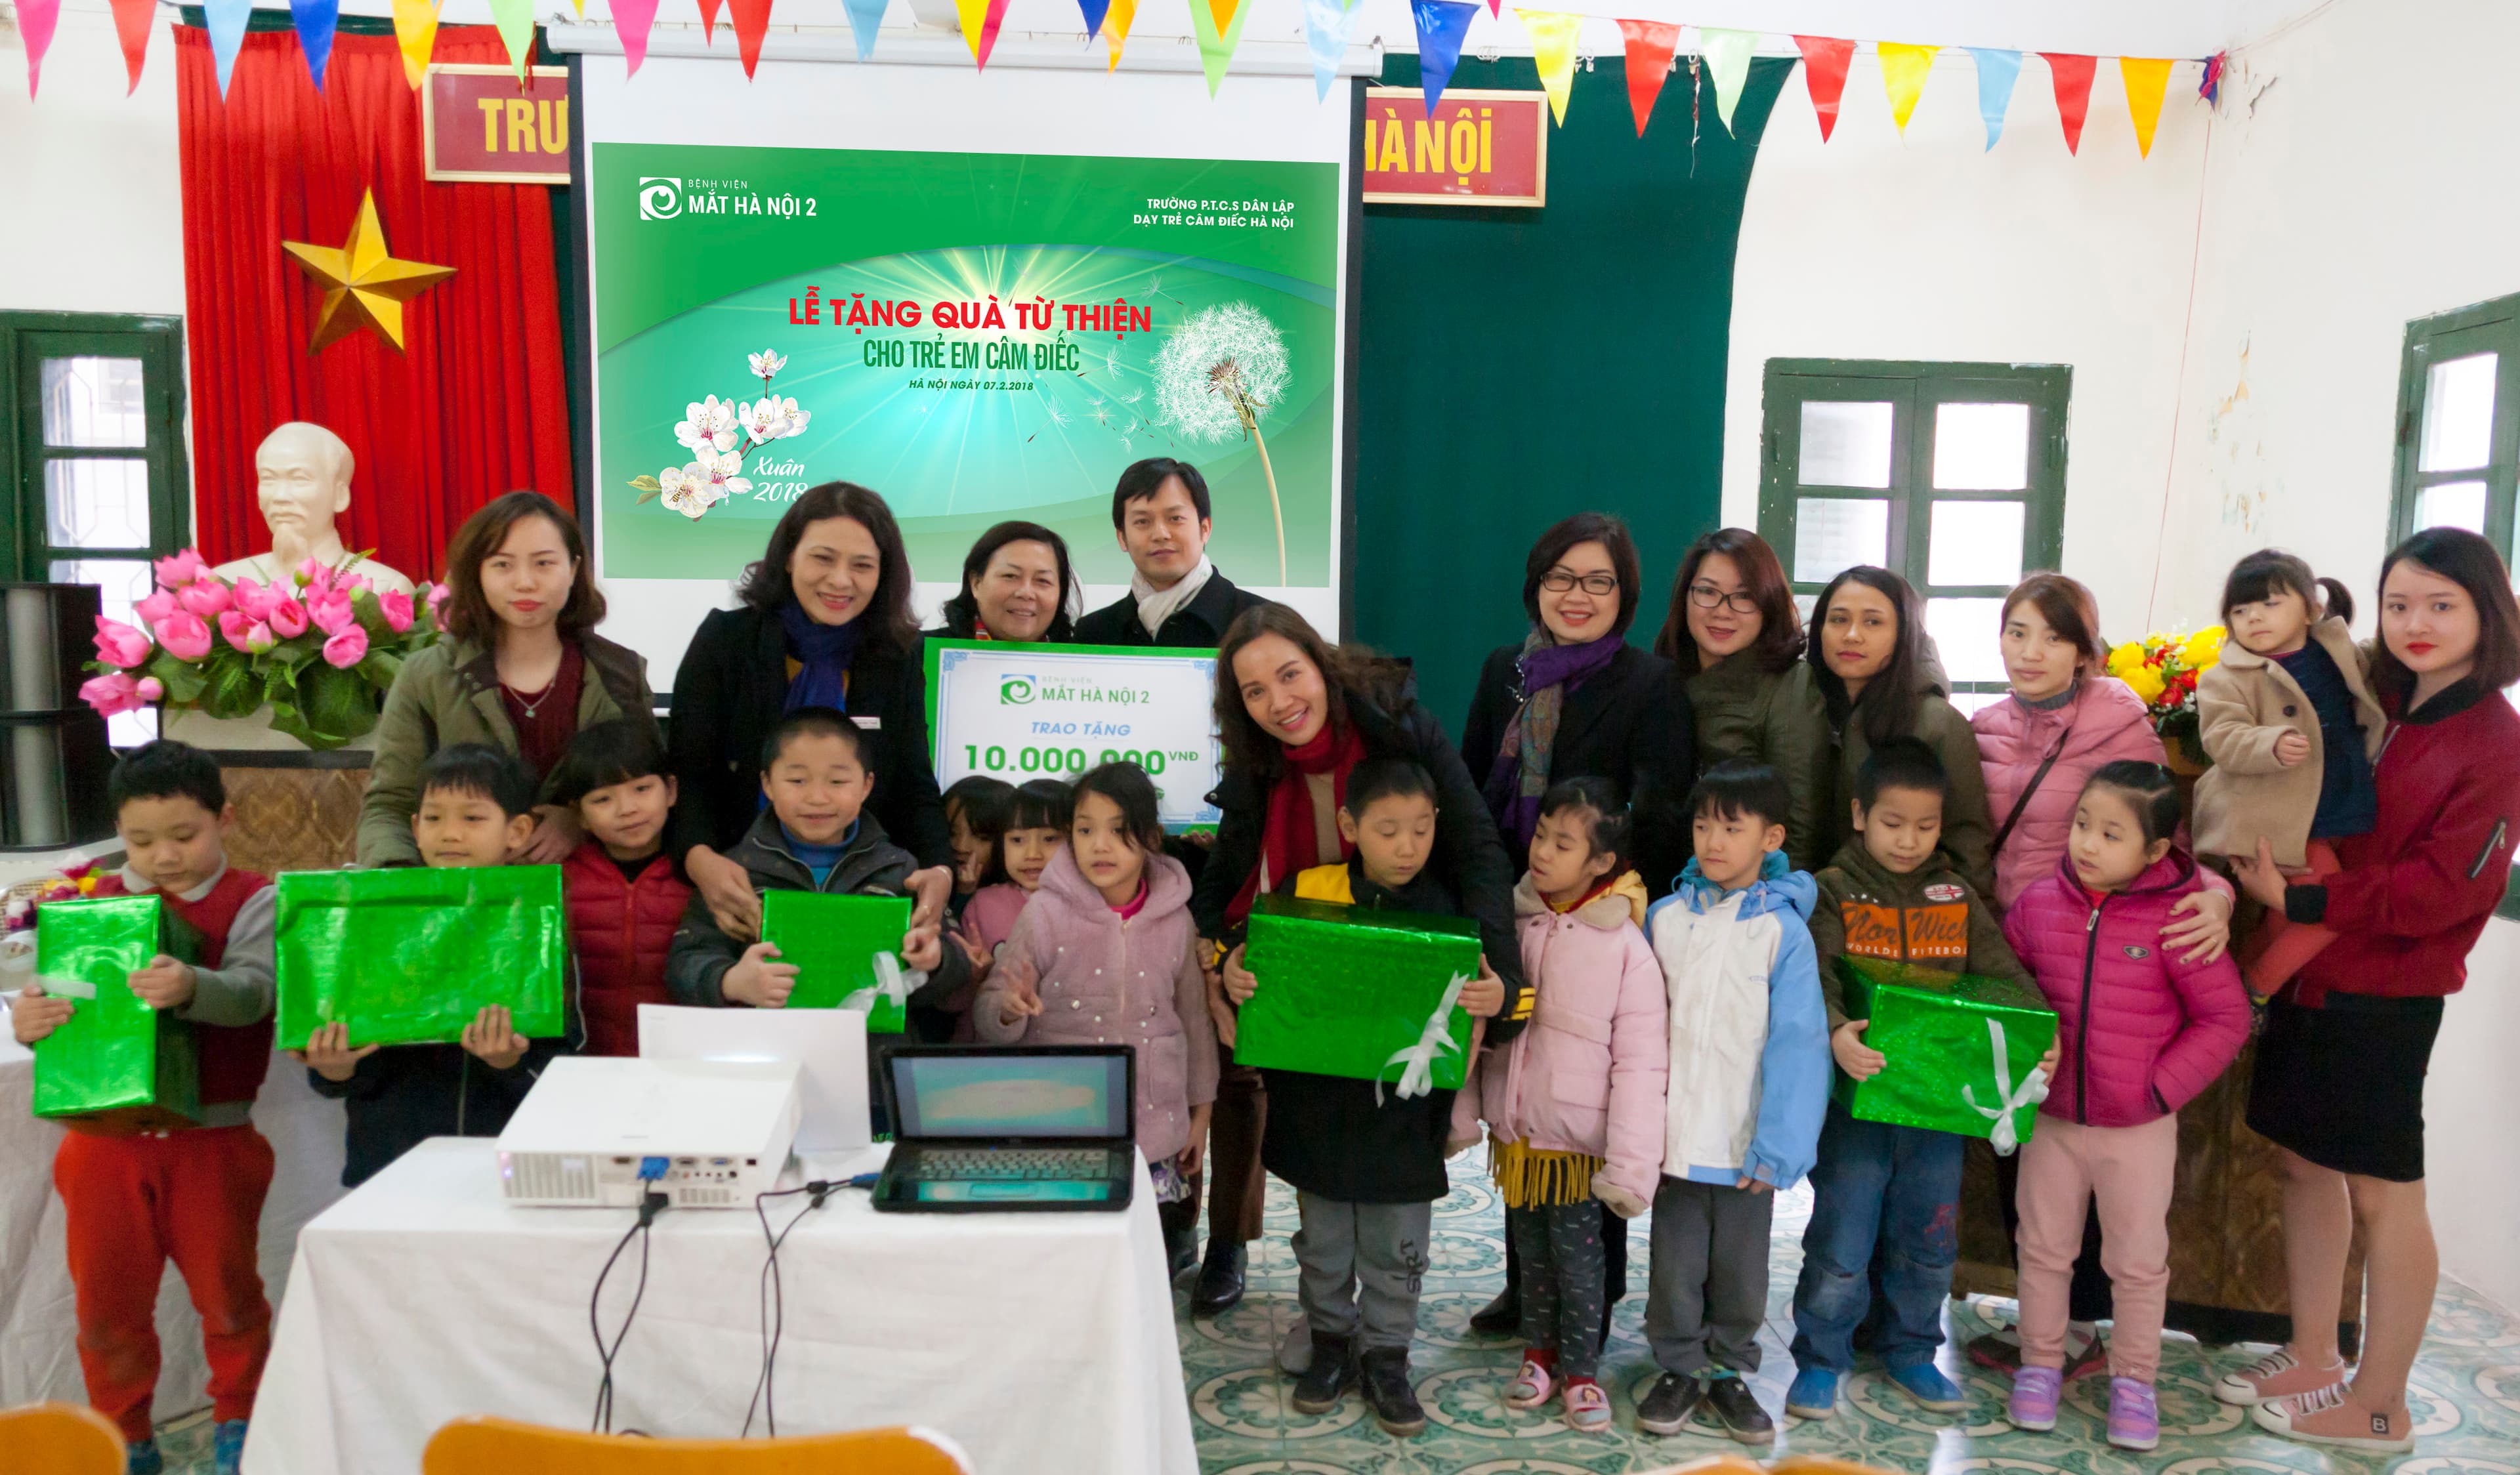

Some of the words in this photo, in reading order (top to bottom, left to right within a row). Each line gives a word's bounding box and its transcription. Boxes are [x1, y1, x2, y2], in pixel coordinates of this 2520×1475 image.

[688, 178, 717, 189] BỆNH
[722, 179, 747, 190] VIỆN
[689, 188, 728, 214] MẮT
[734, 192, 762, 215] HÀ
[767, 193, 800, 219] NỘI
[805, 197, 817, 216] 2
[1147, 196, 1197, 209] TRƯỜNG
[1201, 200, 1239, 211] P.T.C.S
[1243, 199, 1269, 211] DÂN
[1272, 199, 1294, 215] LẬP
[1133, 215, 1158, 227] DẠY
[1162, 212, 1181, 225] TRẺ
[1185, 213, 1214, 226] CÂM
[1218, 213, 1246, 227] ĐIẾC
[1251, 215, 1267, 227] HÀ
[1272, 216, 1293, 230] NỘI
[789, 285, 820, 325] LỄ
[830, 293, 922, 335] TẶNG
[932, 294, 1005, 329] QUÀ
[1015, 295, 1055, 330] TỪ
[1062, 298, 1151, 340] THIỆN
[864, 339, 904, 367] CHO
[910, 333, 946, 368] TRẺ
[952, 342, 979, 369] EM
[986, 335, 1028, 370] CÂM
[1034, 330, 1080, 371] ĐIẾC
[909, 378, 924, 388] HÀ
[927, 379, 947, 391] NỘI
[950, 379, 980, 389] NGÀY
[984, 381, 1034, 390] 07.2.2018
[753, 456, 805, 478] Xuân
[753, 482, 808, 503] 2018
[1041, 684, 1075, 701] MẮT
[1081, 686, 1103, 702] HÀ
[1108, 687, 1136, 706] NỘI
[1141, 690, 1150, 703] 2
[1031, 722, 1076, 734] TRAO
[1083, 720, 1131, 739] TẶNG
[1169, 751, 1198, 761] VNĐ
